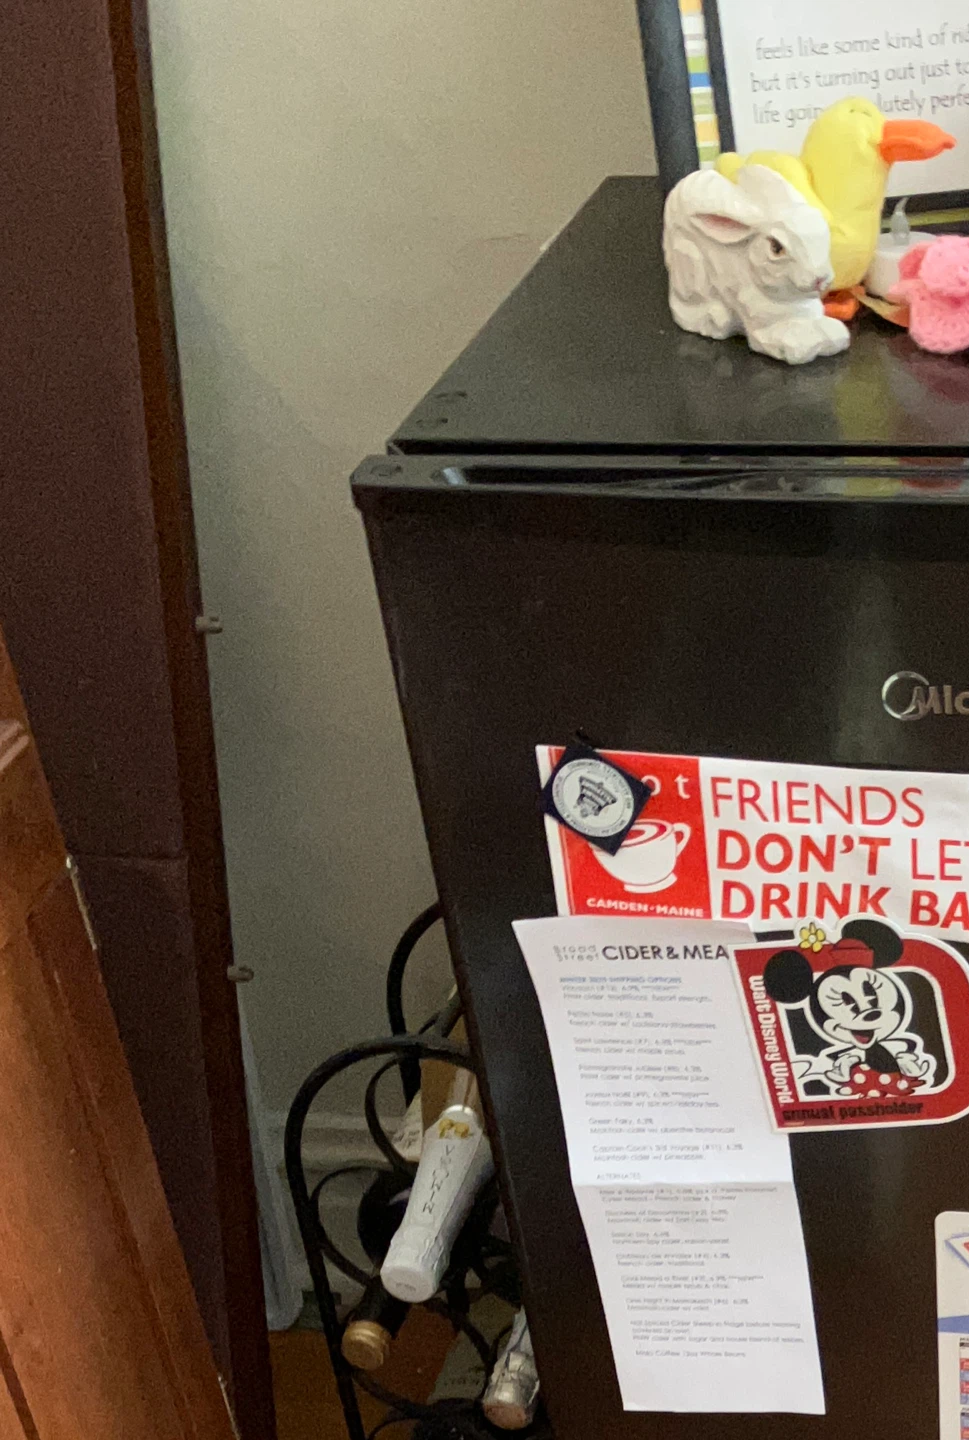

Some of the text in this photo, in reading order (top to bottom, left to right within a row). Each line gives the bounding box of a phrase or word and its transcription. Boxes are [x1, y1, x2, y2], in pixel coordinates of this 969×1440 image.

[755, 37, 794, 60] feels
[798, 36, 829, 56] like
[834, 38, 880, 54] some
[885, 28, 923, 50] kind
[928, 22, 949, 46] of
[750, 72, 781, 93] but
[785, 70, 811, 90] it's
[815, 67, 880, 89] turning
[885, 63, 916, 81] out
[920, 60, 950, 85] just
[753, 101, 780, 125] life
[785, 107, 823, 128] goin
[709, 776, 926, 828] FRIENDS
[717, 829, 892, 877] DON'T
[721, 879, 892, 921] DRINK
[602, 944, 730, 960] CIDER & MEA
[749, 975, 794, 1104] Walt Disney World
[783, 1102, 923, 1120] annual passholder
